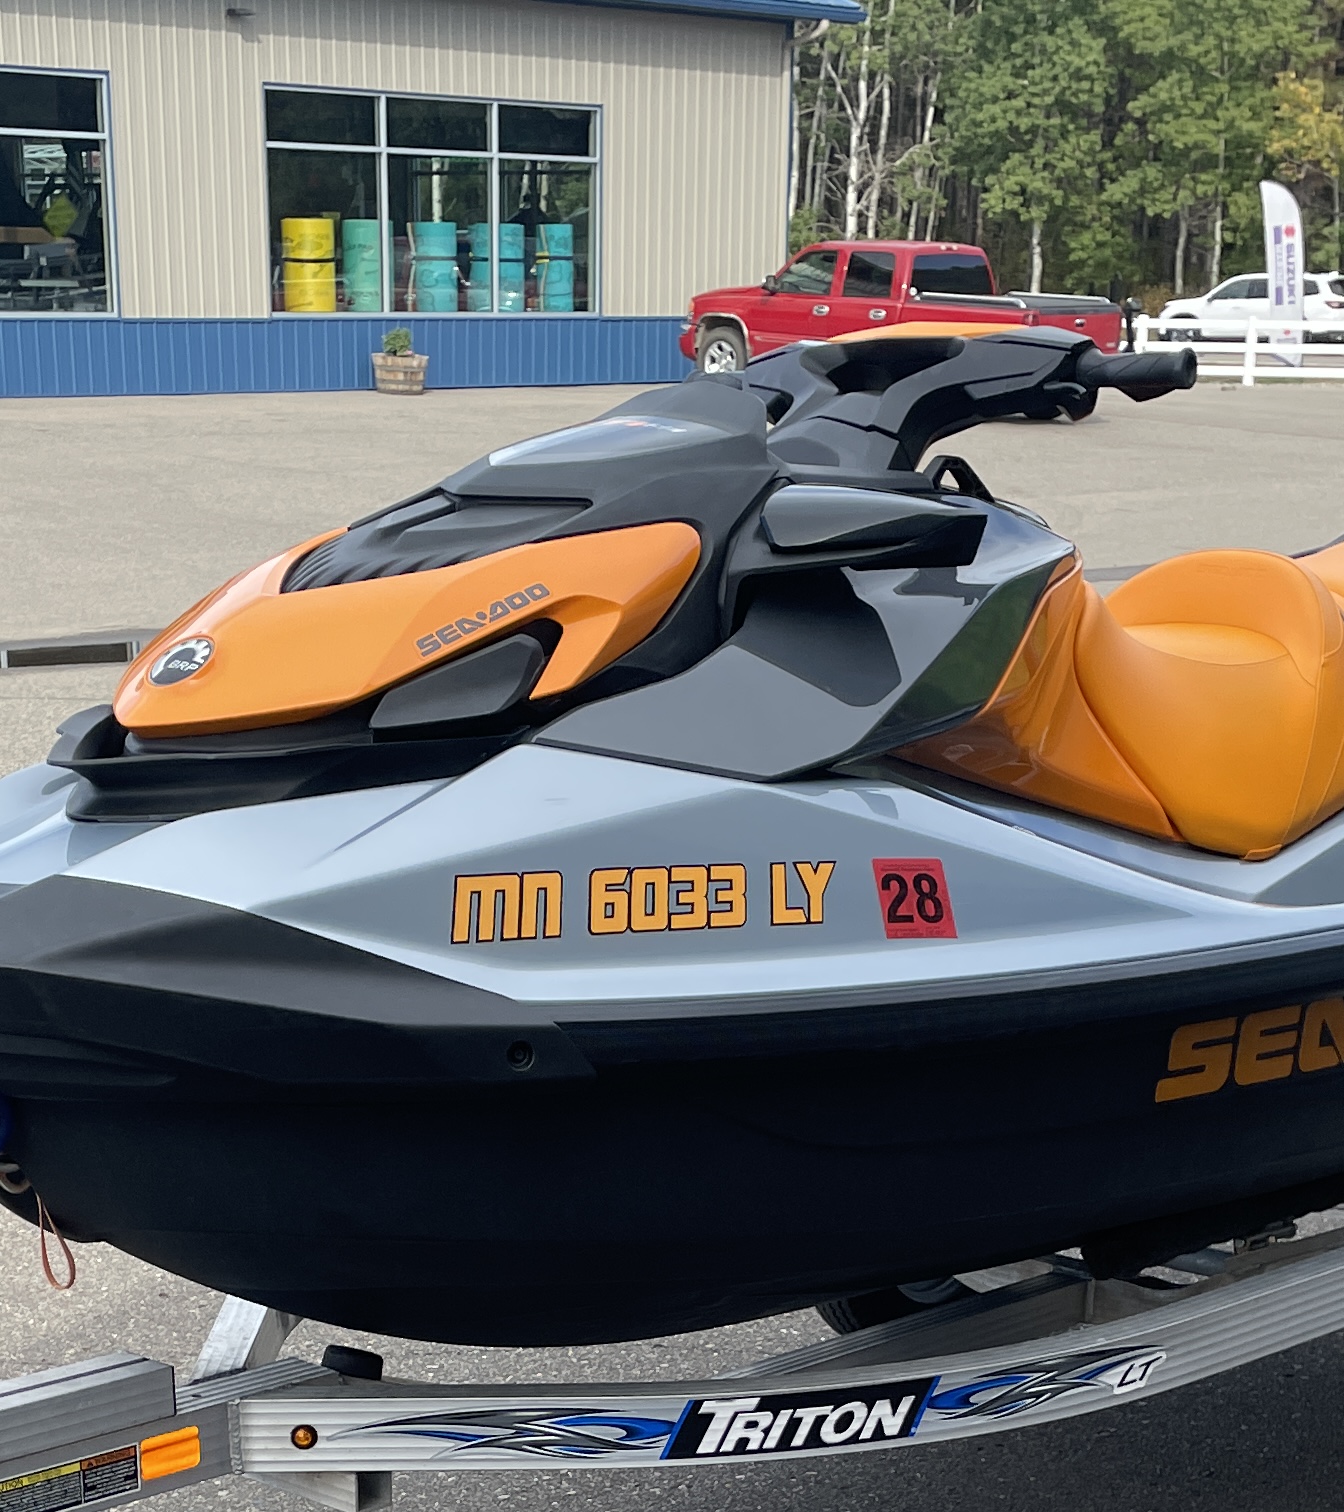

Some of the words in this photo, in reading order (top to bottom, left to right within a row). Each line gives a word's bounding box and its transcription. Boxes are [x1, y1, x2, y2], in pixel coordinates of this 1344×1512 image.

[167, 659, 199, 672] BRP
[450, 870, 563, 945] MN
[587, 863, 747, 936] 6033
[769, 860, 837, 927] LY
[880, 872, 944, 924] 28
[1117, 1355, 1163, 1388] LT
[695, 1396, 919, 1457] TRITON
